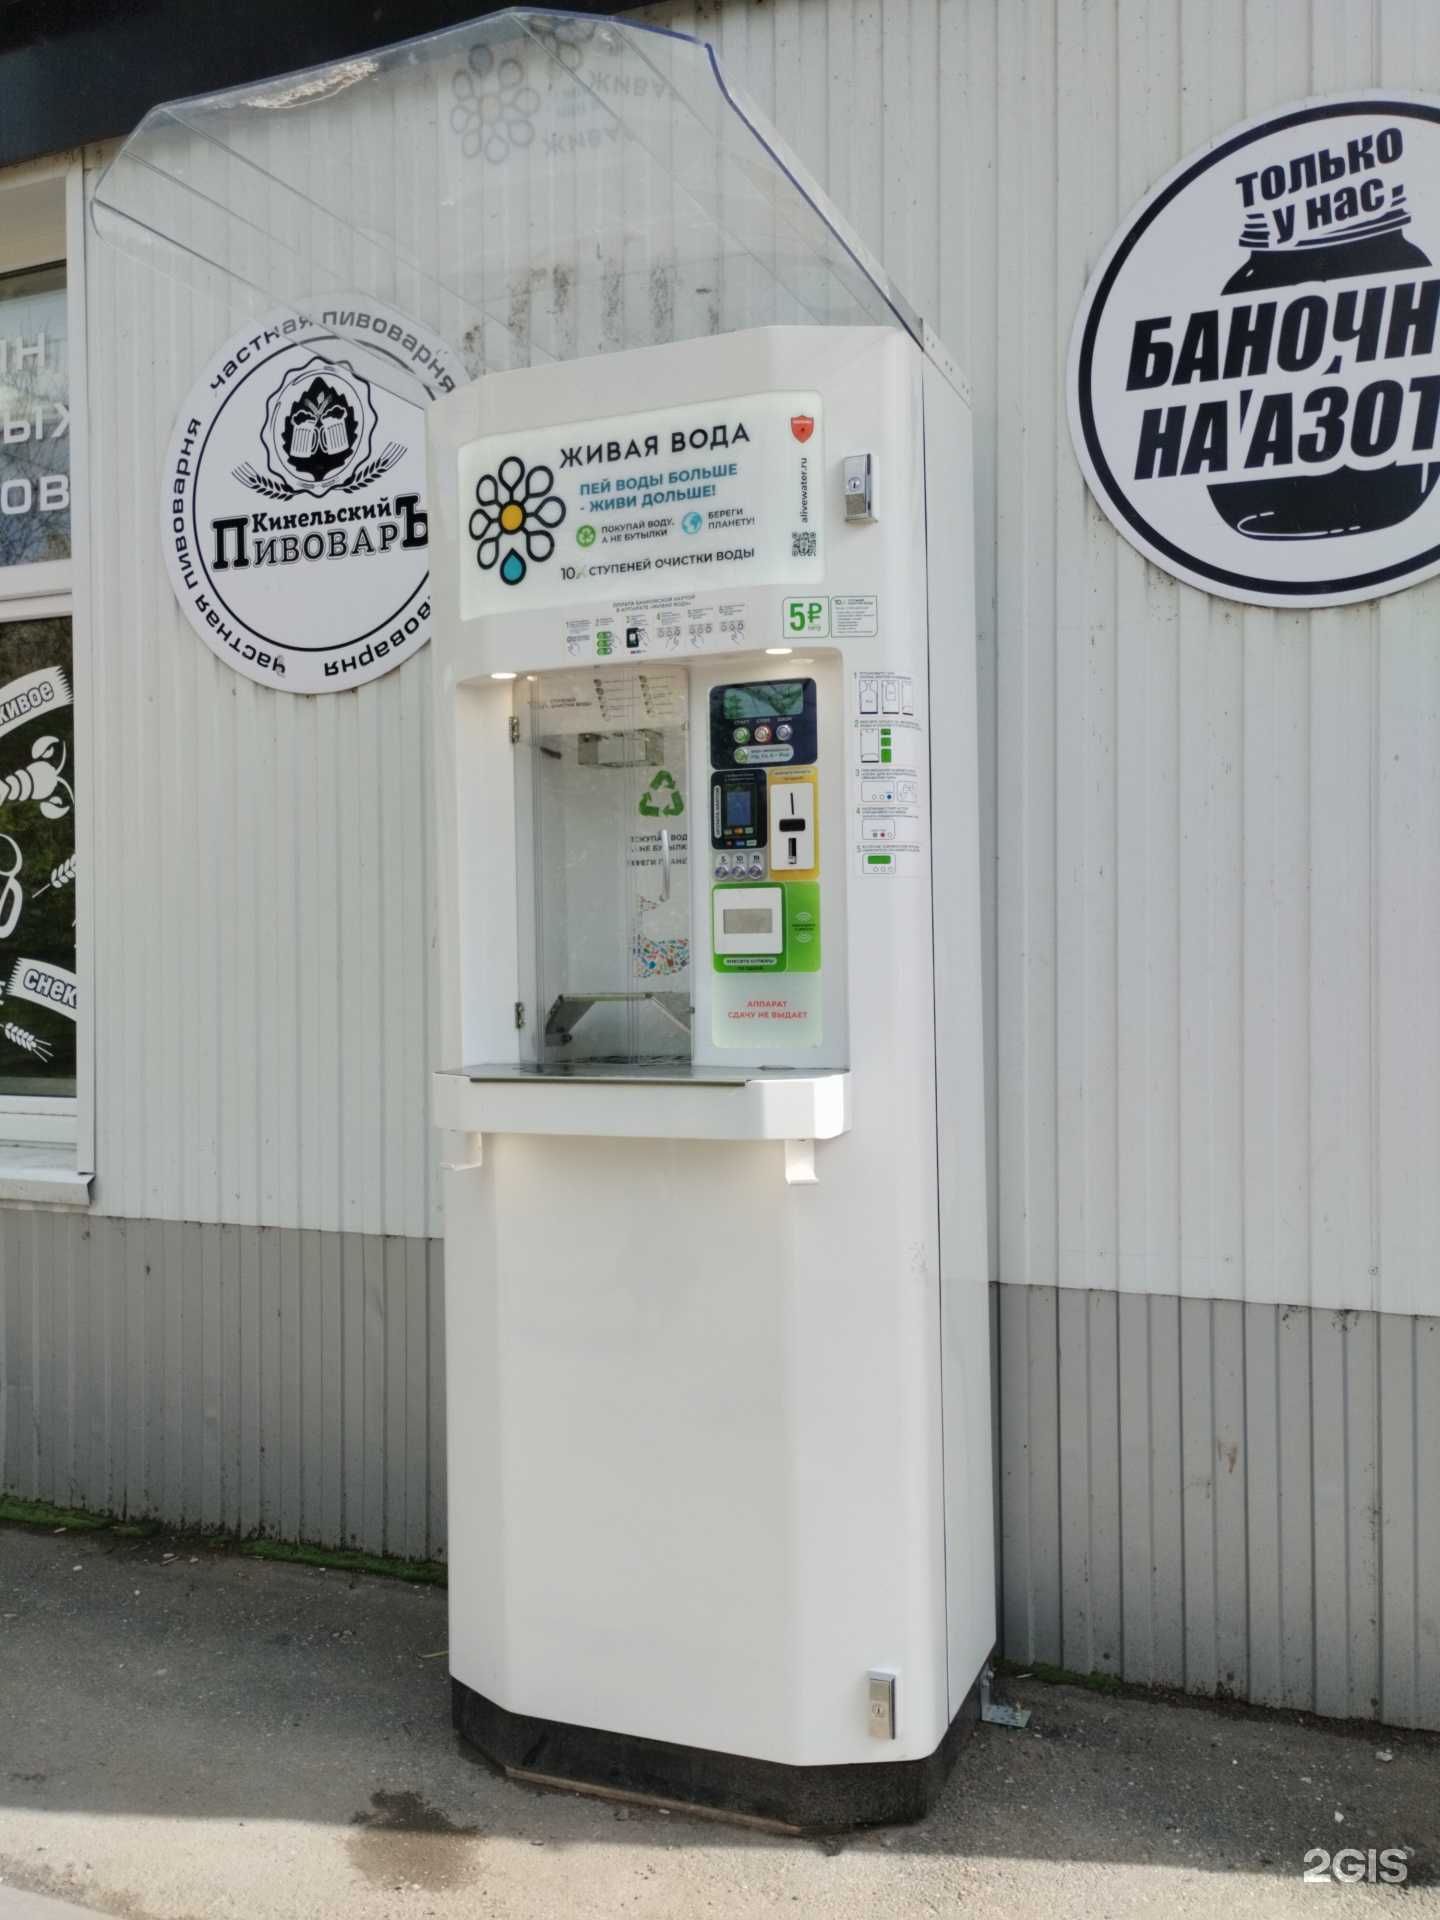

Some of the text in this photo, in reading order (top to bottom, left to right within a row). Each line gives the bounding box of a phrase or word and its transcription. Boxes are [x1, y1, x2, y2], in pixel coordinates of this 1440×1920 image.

[1125, 279, 1440, 392] БАНОЧН
[322, 310, 456, 394] пивоварня
[560, 423, 751, 469] ЖИВАЯ ВОДА
[1134, 399, 1229, 481] НА
[580, 463, 738, 496] ПЕЙ ВОДЫ БОЛЬШЕ
[172, 417, 203, 590] пивоварня
[590, 496, 638, 512] ЖИВИ
[641, 484, 717, 508] ДОЛЬШЕ!
[252, 497, 393, 533] Кинельский
[601, 520, 645, 534] ПОКУПАЙ
[708, 508, 744, 520] БЕРЕГИ
[708, 517, 756, 530] ПЛАНЕТУ!
[611, 534, 622, 543] НЕ
[624, 529, 668, 542] БУТЫЛКИ
[588, 558, 651, 577] СТУПЕНЕЙ
[655, 553, 713, 569] ОЧИСТКИ
[716, 547, 755, 561] ВОДЫ
[324, 600, 431, 678] воварня
[728, 1010, 808, 1020] СДАЧУ НЕ ВЫДАЕТ
[747, 1000, 788, 1008] АППАРАТ
